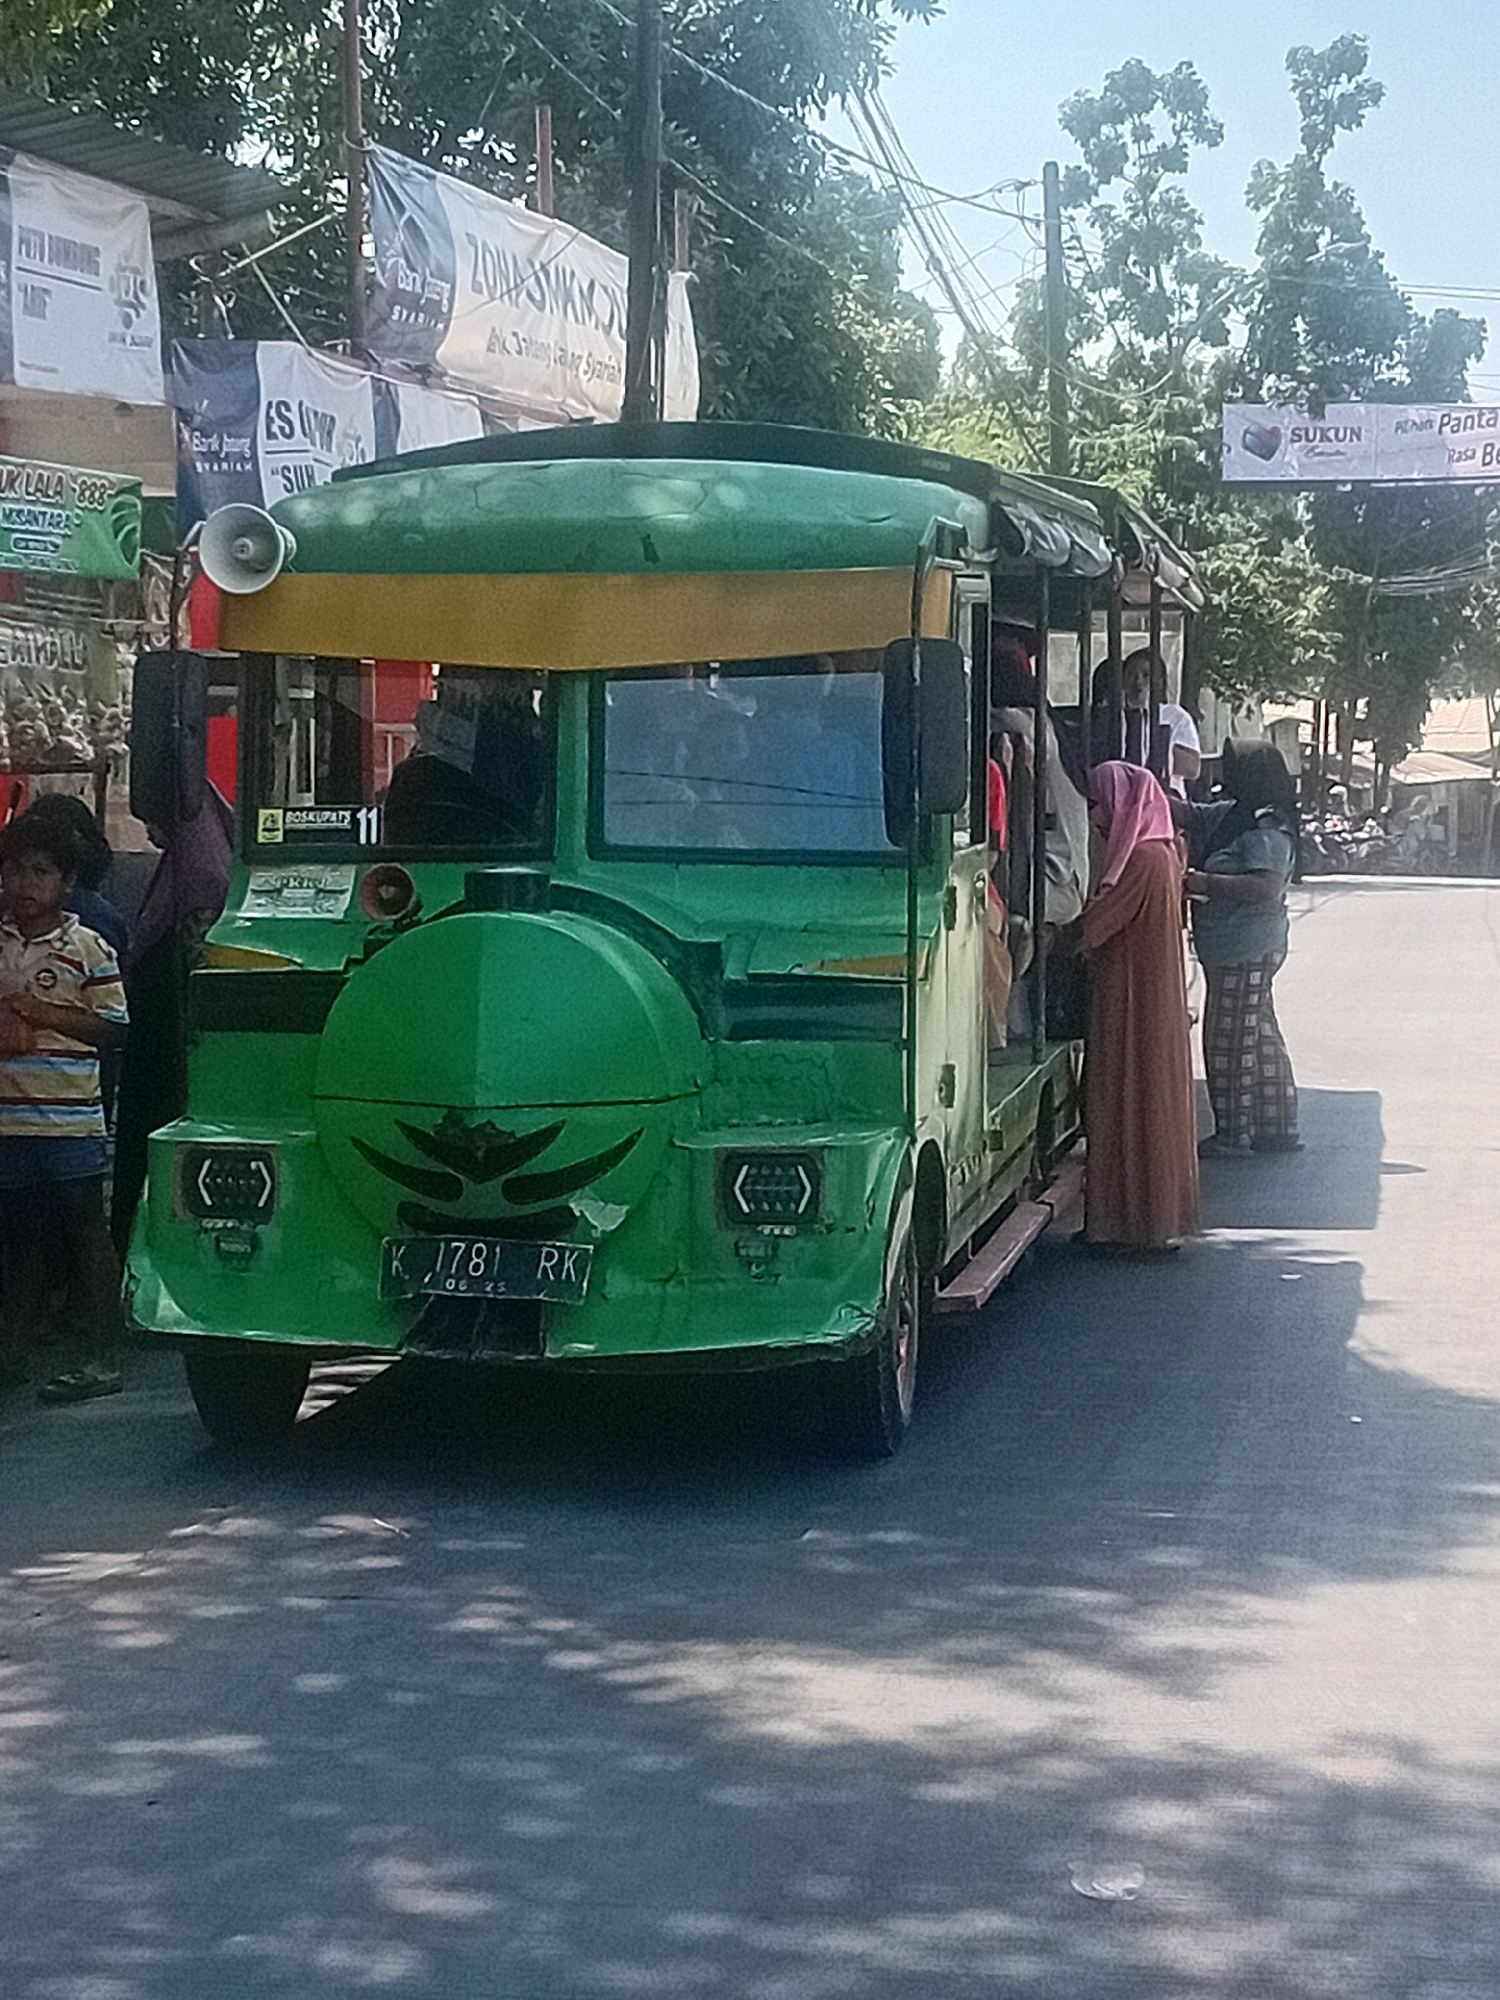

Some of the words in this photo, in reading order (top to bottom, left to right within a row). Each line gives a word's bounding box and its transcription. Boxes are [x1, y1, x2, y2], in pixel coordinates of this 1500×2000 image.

[465, 232, 525, 310] ZONA
[265, 399, 295, 441] ES
[1290, 427, 1362, 443] SUKUN
[1438, 411, 1500, 435] Panta
[1448, 448, 1476, 464] Rasa
[25, 470, 64, 501] LALA
[357, 807, 378, 845] 11
[392, 1245, 406, 1276] K
[436, 1241, 501, 1277] 1781
[537, 1246, 579, 1283] RK
